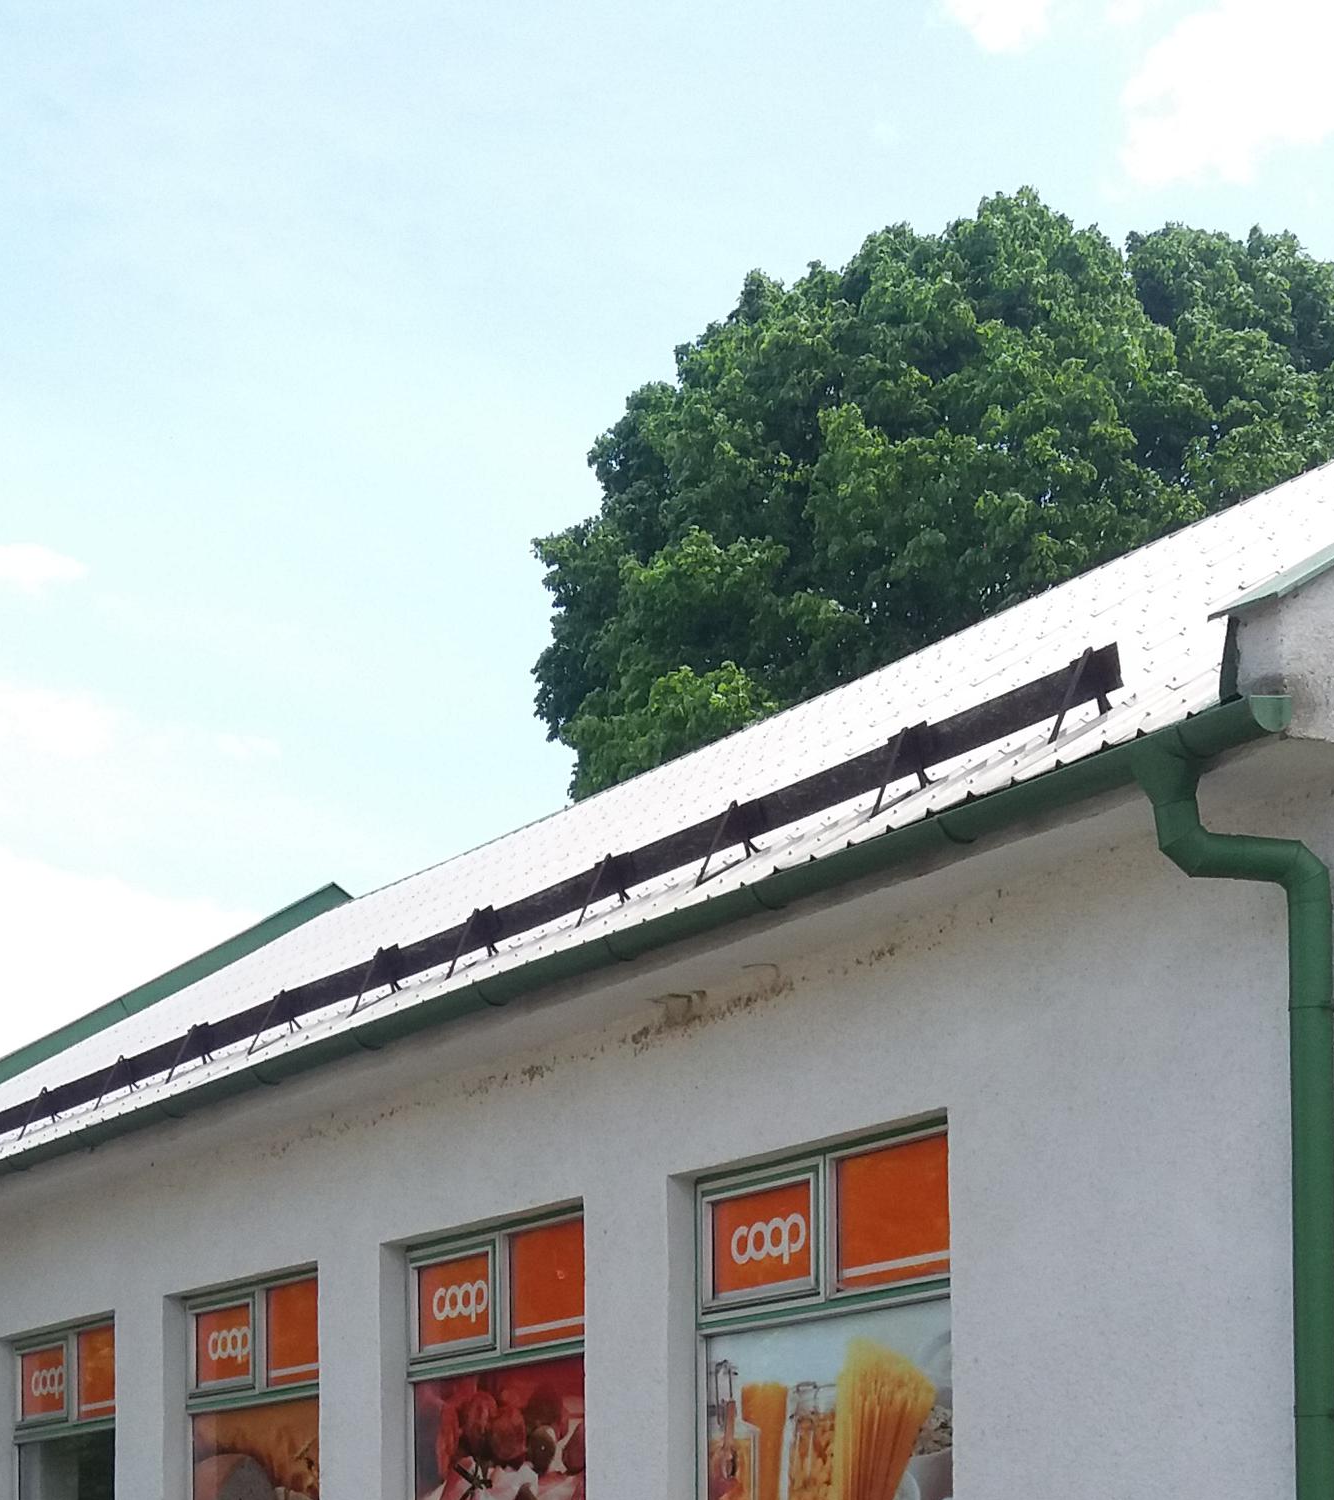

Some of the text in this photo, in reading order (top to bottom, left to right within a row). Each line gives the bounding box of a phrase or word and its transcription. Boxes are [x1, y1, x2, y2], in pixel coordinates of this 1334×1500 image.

[731, 1212, 806, 1265] coop
[433, 1280, 488, 1323] coop
[208, 1326, 251, 1364] coop
[31, 1365, 65, 1399] coop
